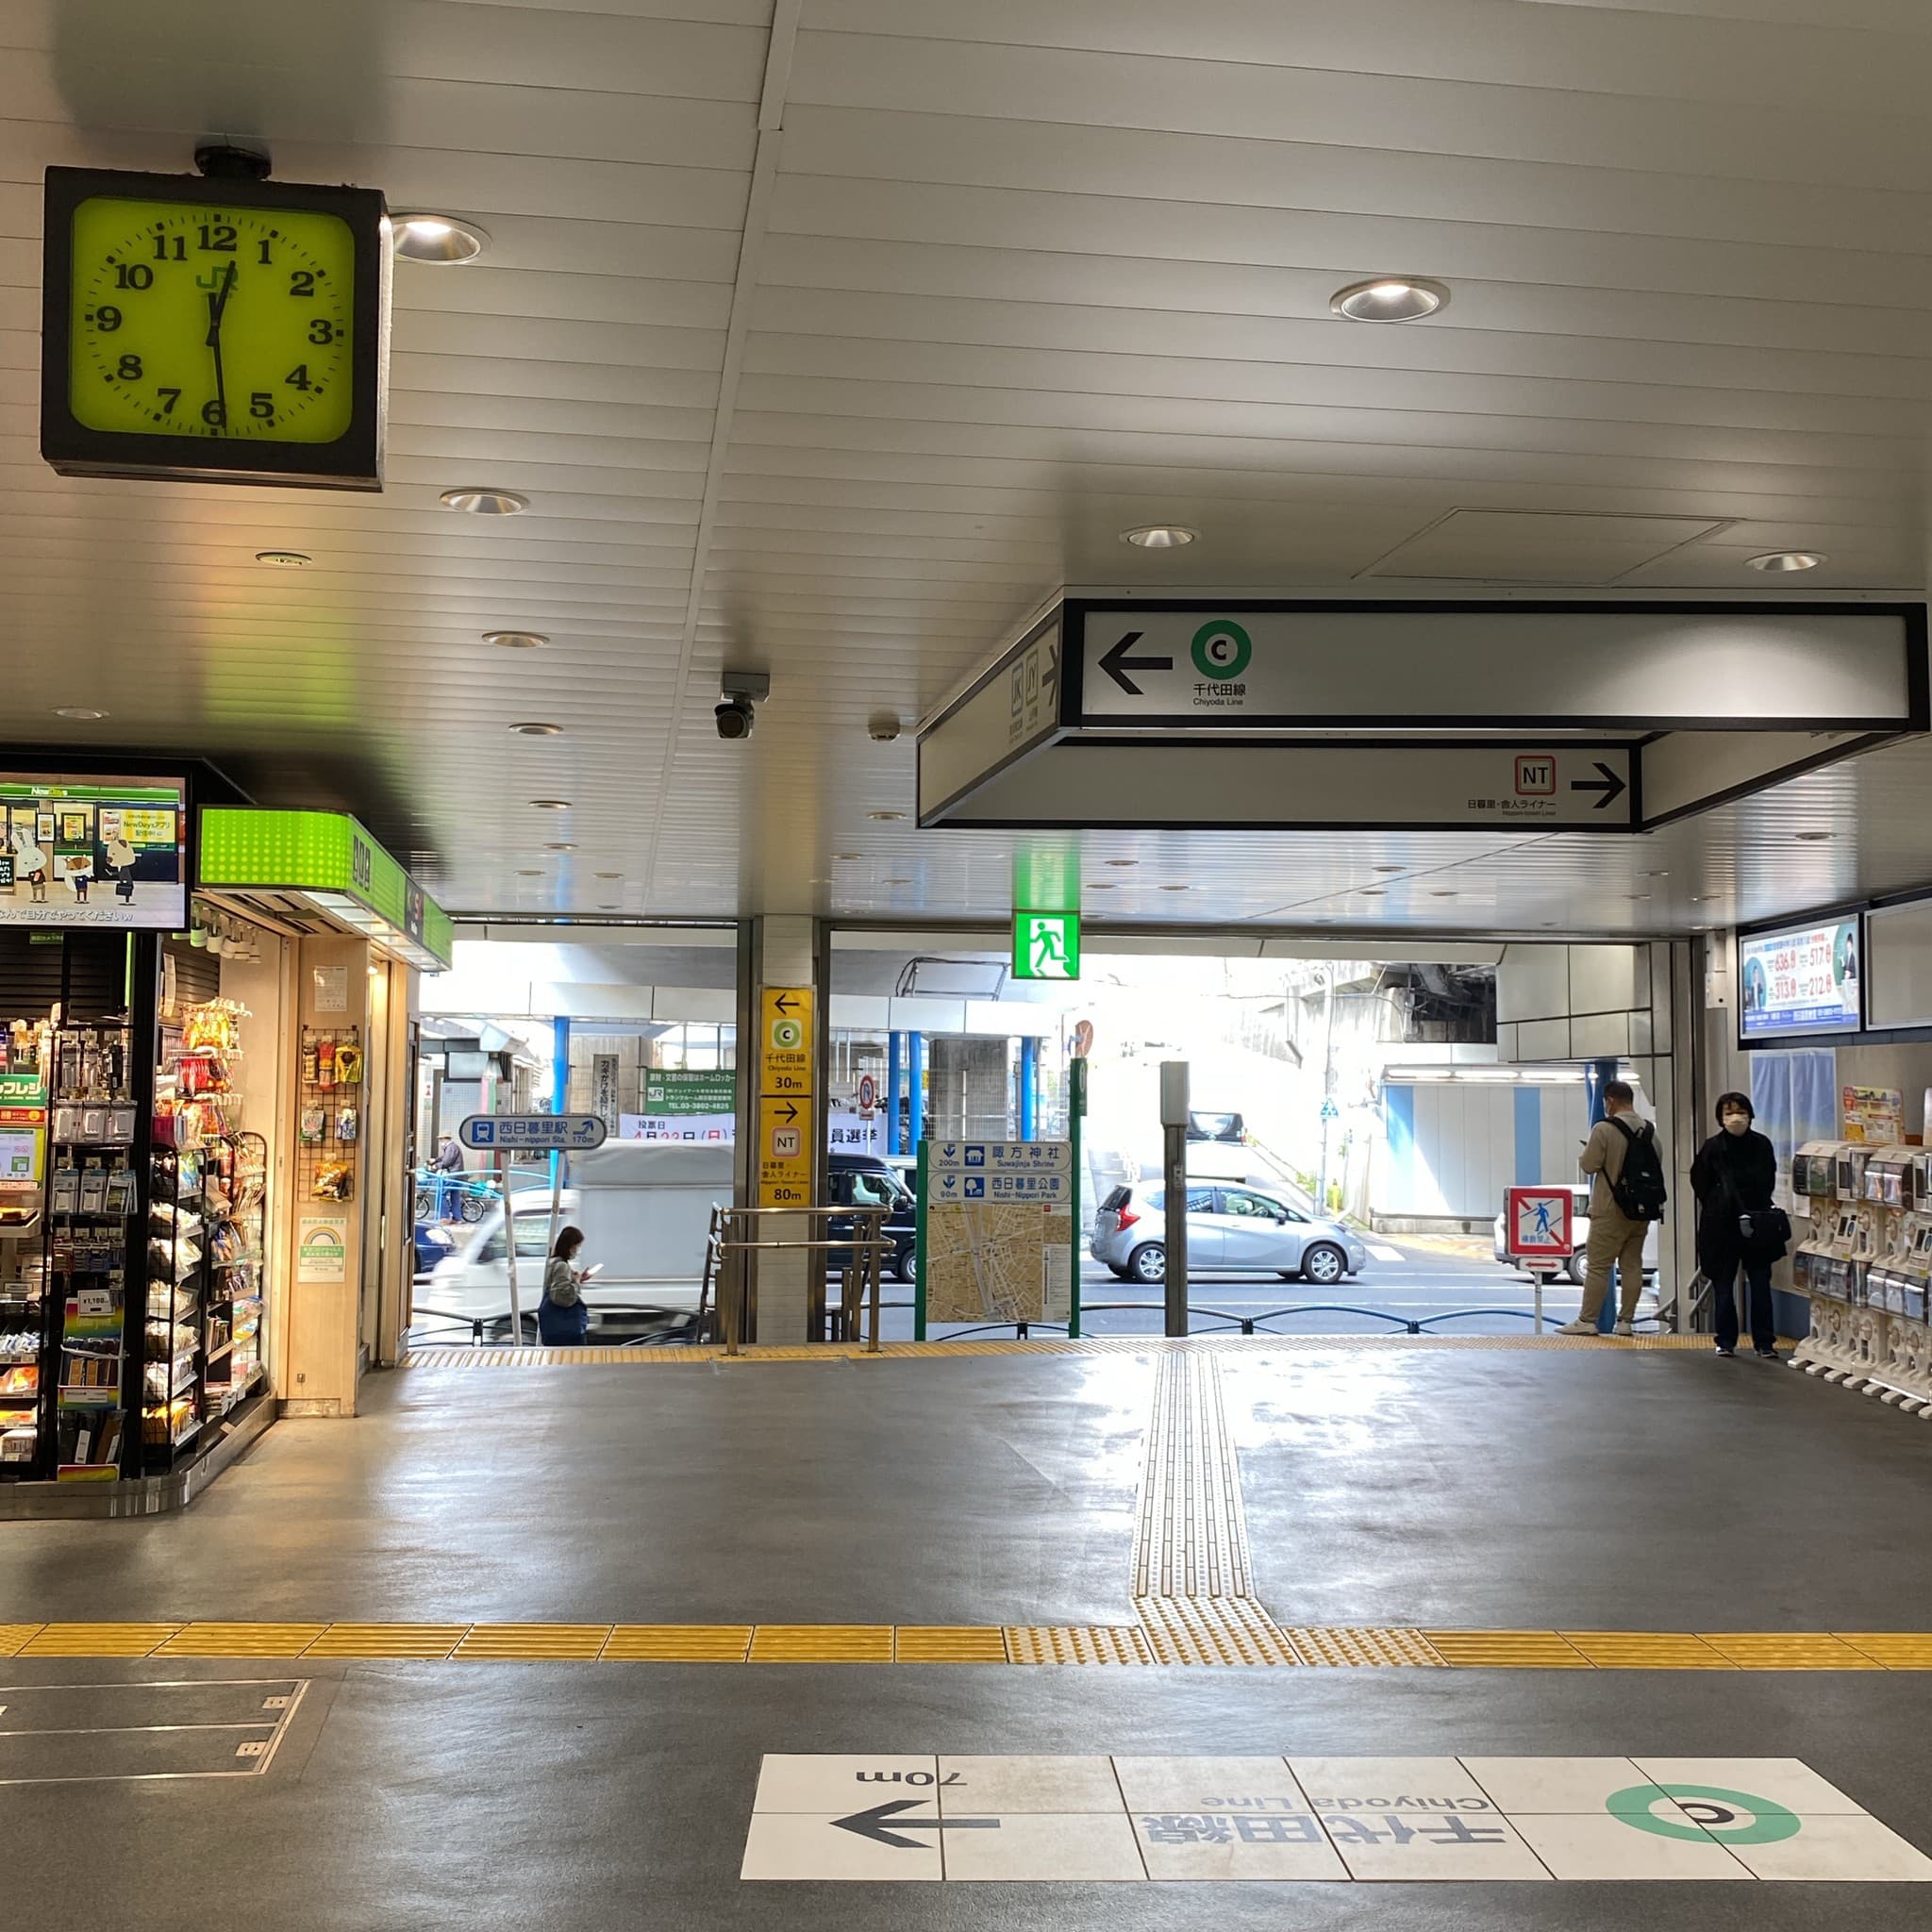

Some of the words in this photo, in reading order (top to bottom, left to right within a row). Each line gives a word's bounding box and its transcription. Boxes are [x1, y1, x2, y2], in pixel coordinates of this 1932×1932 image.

[197, 225, 237, 251] 12
[154, 236, 188, 260] 11
[258, 240, 273, 264] 1
[114, 264, 153, 290] 10
[196, 266, 239, 291] JR
[290, 271, 314, 296] 2
[96, 306, 122, 331] 9
[308, 319, 333, 344] 3
[117, 355, 142, 380] 8
[286, 364, 311, 391] 4
[157, 388, 181, 413] 7
[249, 392, 275, 418] 5
[202, 400, 226, 425] 6
[1211, 640, 1226, 659] C
[1193, 683, 1246, 696] 千代田線
[1193, 698, 1224, 707] Chiyoda
[1523, 767, 1548, 784] NT
[31, 787, 69, 796] NewDays
[765, 1053, 807, 1063] 千代田線
[775, 1076, 803, 1089] 30m
[648, 1089, 662, 1098] JR
[499, 1121, 568, 1135] 西日暮里駅
[638, 1120, 666, 1130] 投票日
[776, 1137, 795, 1148] NT
[939, 1158, 960, 1167] 200m
[997, 1159, 1031, 1169] Suwajinja
[1033, 1159, 1055, 1168] Shrine
[991, 1177, 1059, 1191] 西日暮里公園
[774, 1189, 802, 1201] 80m
[856, 1772, 968, 1786] 70m
[1200, 1795, 1294, 1810] Line
[1312, 1795, 1491, 1811] Chiyoda
[1676, 1803, 1735, 1824] C
[1141, 1814, 1507, 1845] 千代田線
